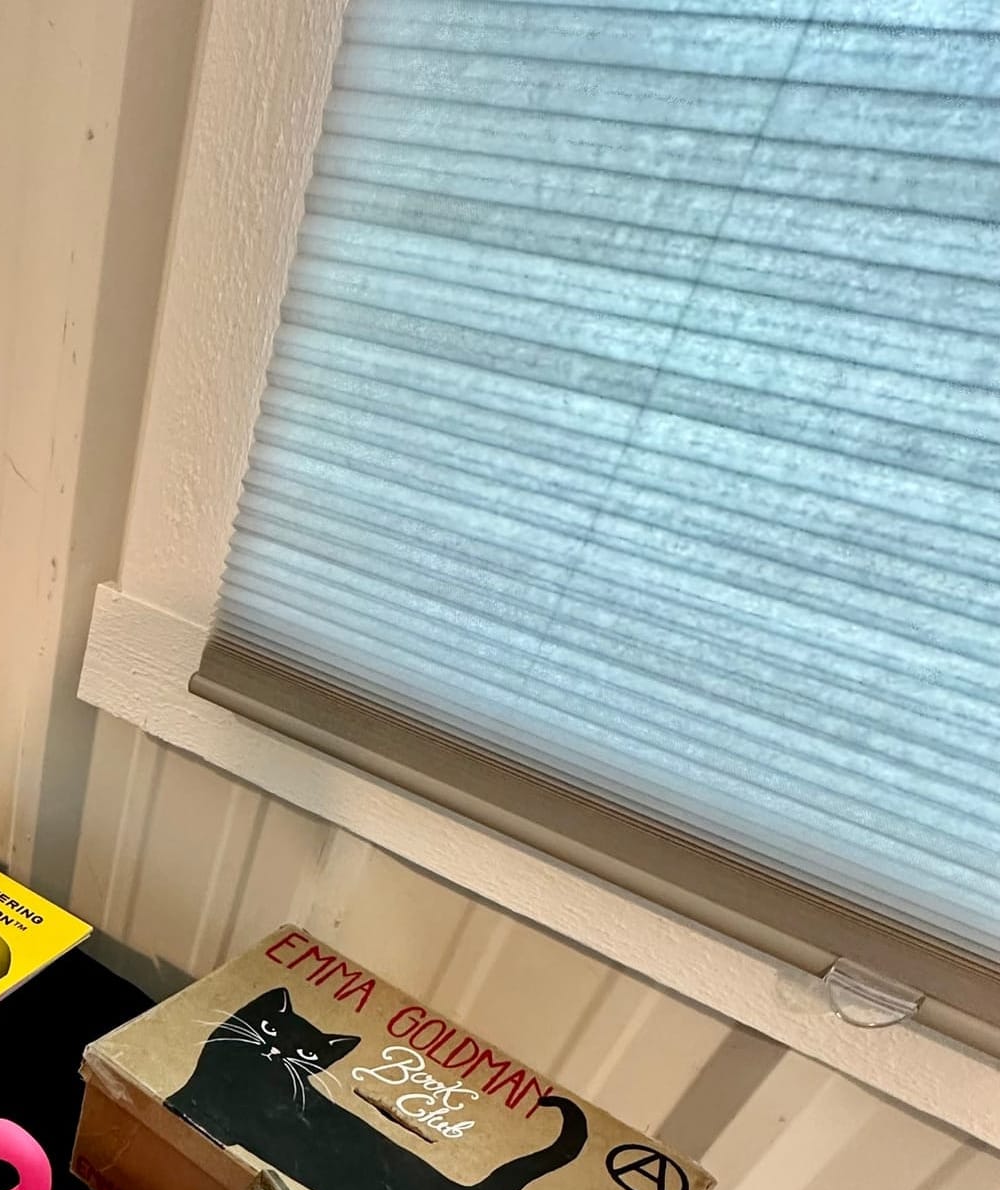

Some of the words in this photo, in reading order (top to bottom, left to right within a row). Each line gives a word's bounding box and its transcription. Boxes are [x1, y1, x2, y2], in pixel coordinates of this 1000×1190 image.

[264, 930, 379, 1016] EMMA
[385, 1003, 556, 1120] GOLDMAN
[351, 1046, 480, 1111] Book
[394, 1092, 476, 1140] Club
